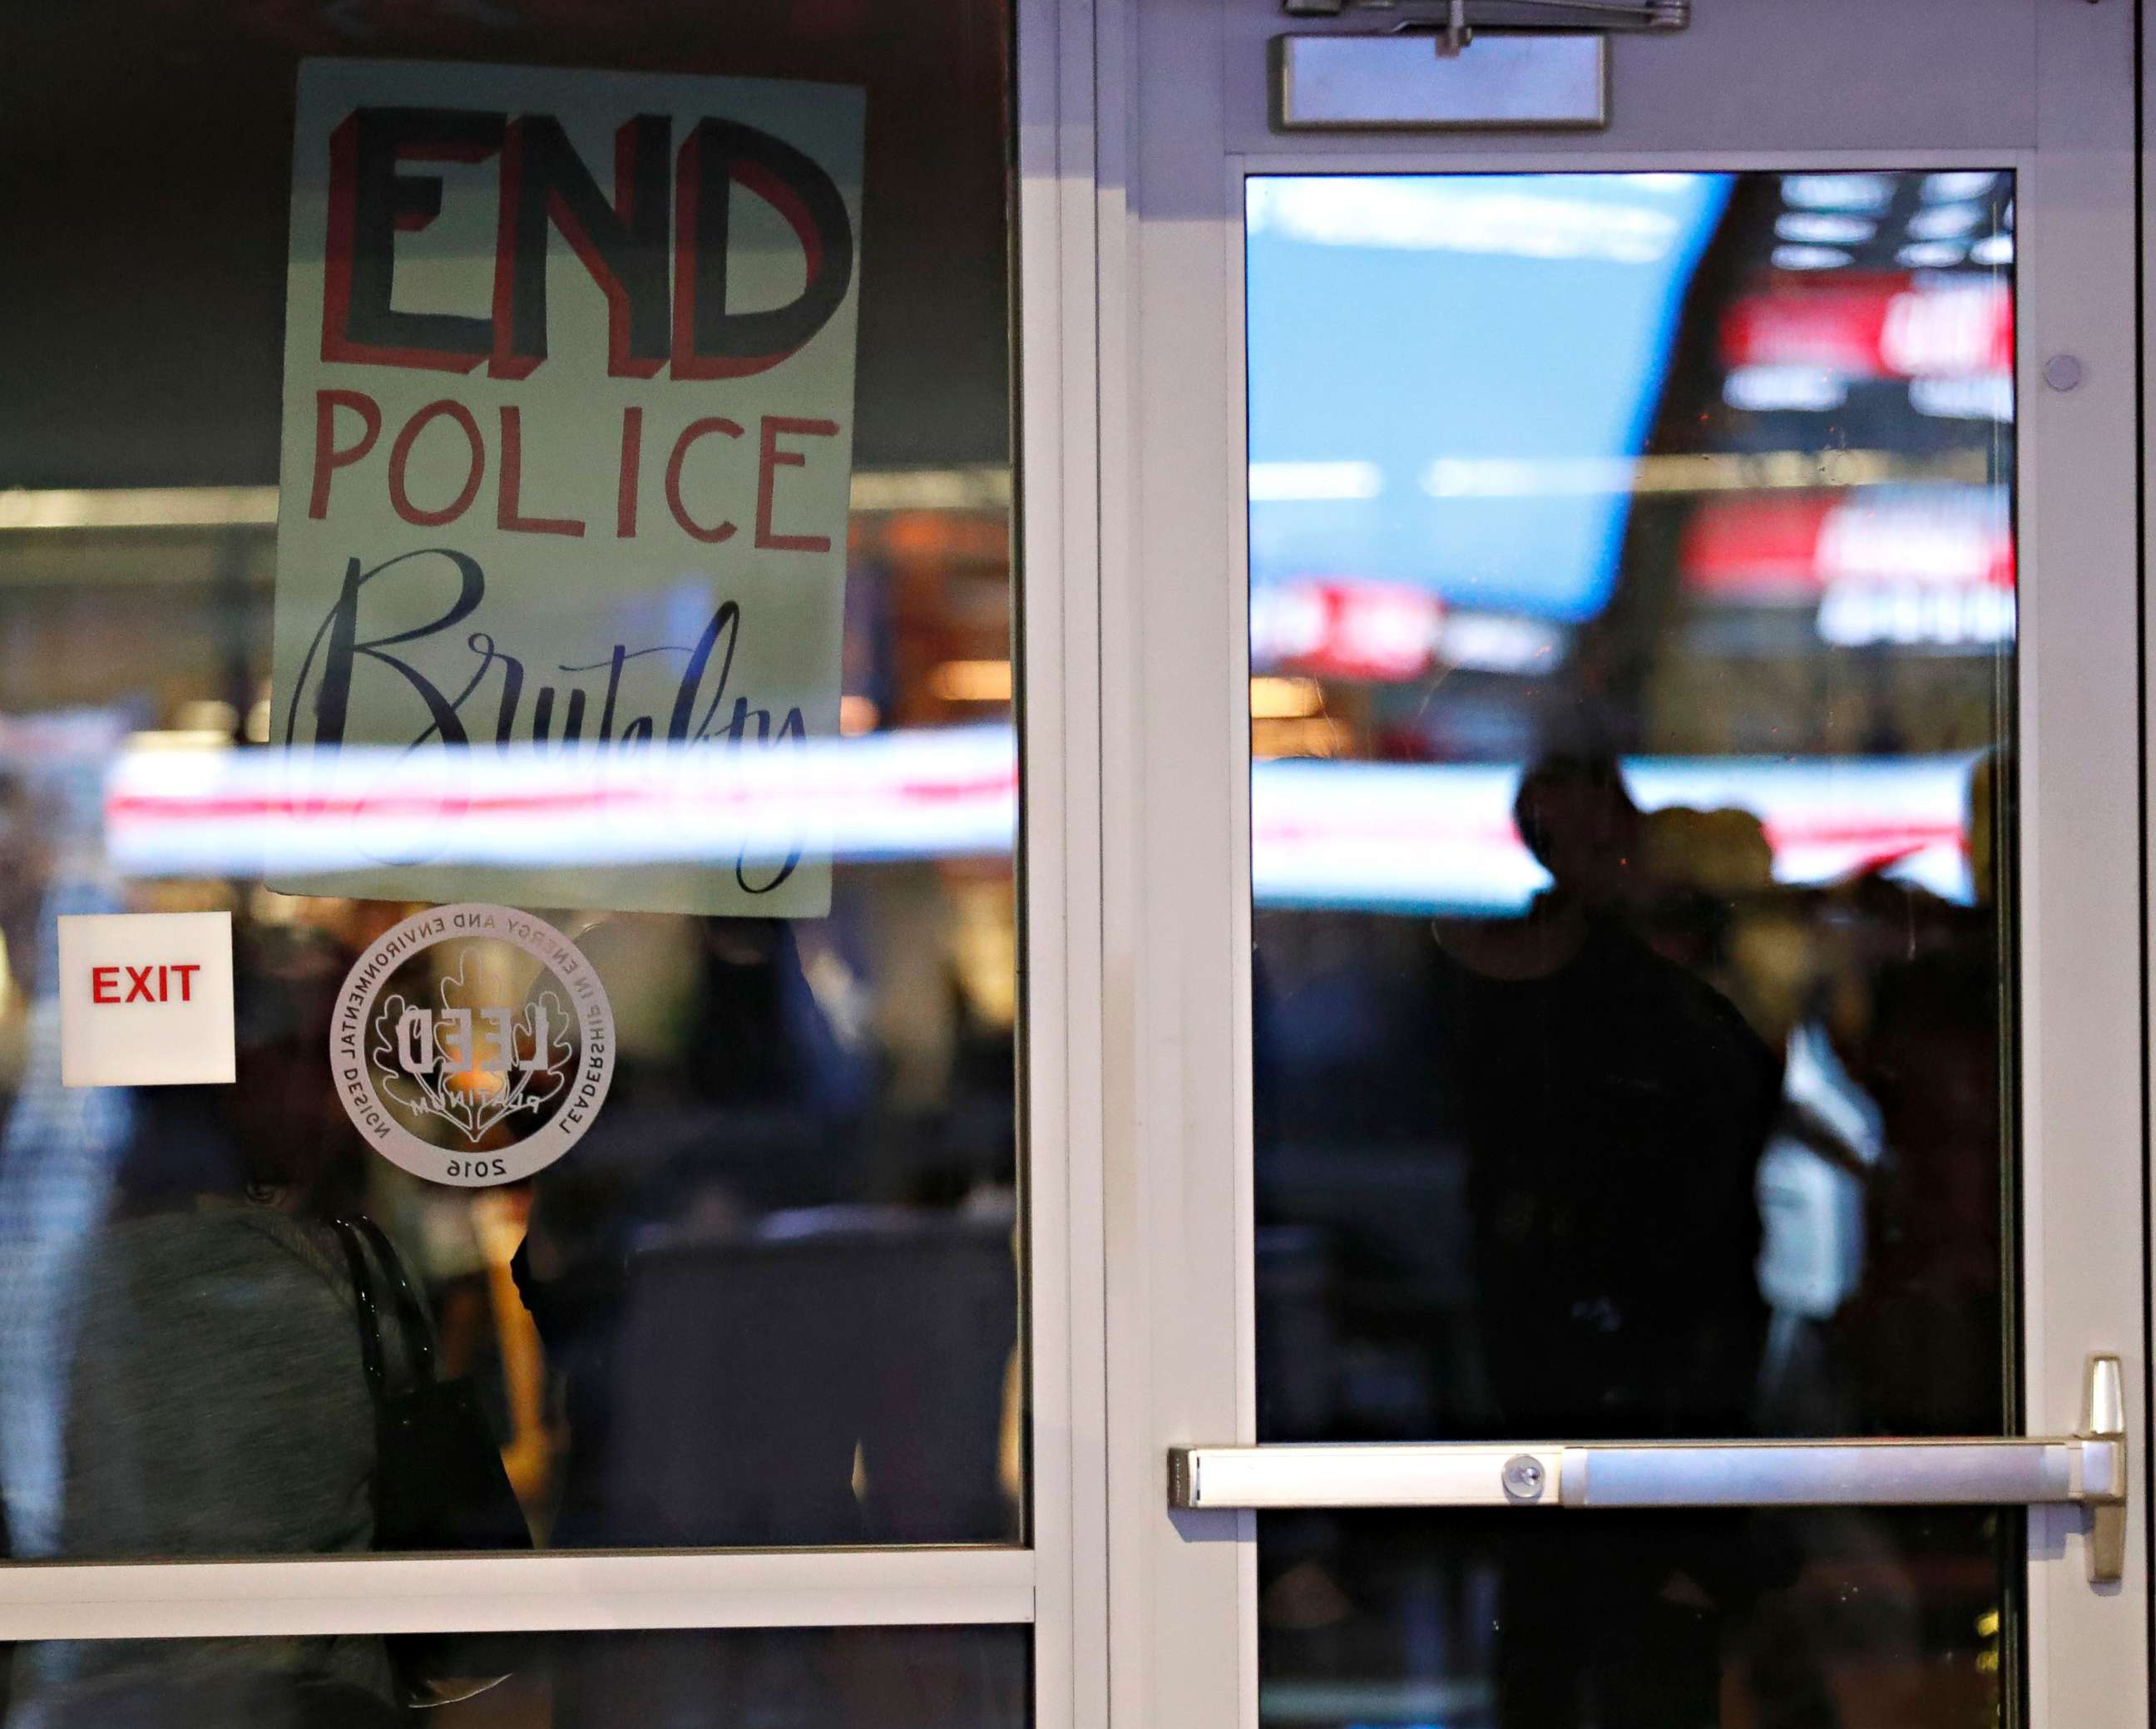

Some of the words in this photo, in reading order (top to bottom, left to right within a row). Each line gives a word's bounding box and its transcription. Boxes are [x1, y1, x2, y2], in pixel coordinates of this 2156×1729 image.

[320, 106, 853, 380] END
[308, 389, 841, 552] POLICE
[284, 548, 808, 894] Brutalty
[92, 965, 200, 1004] EXIT
